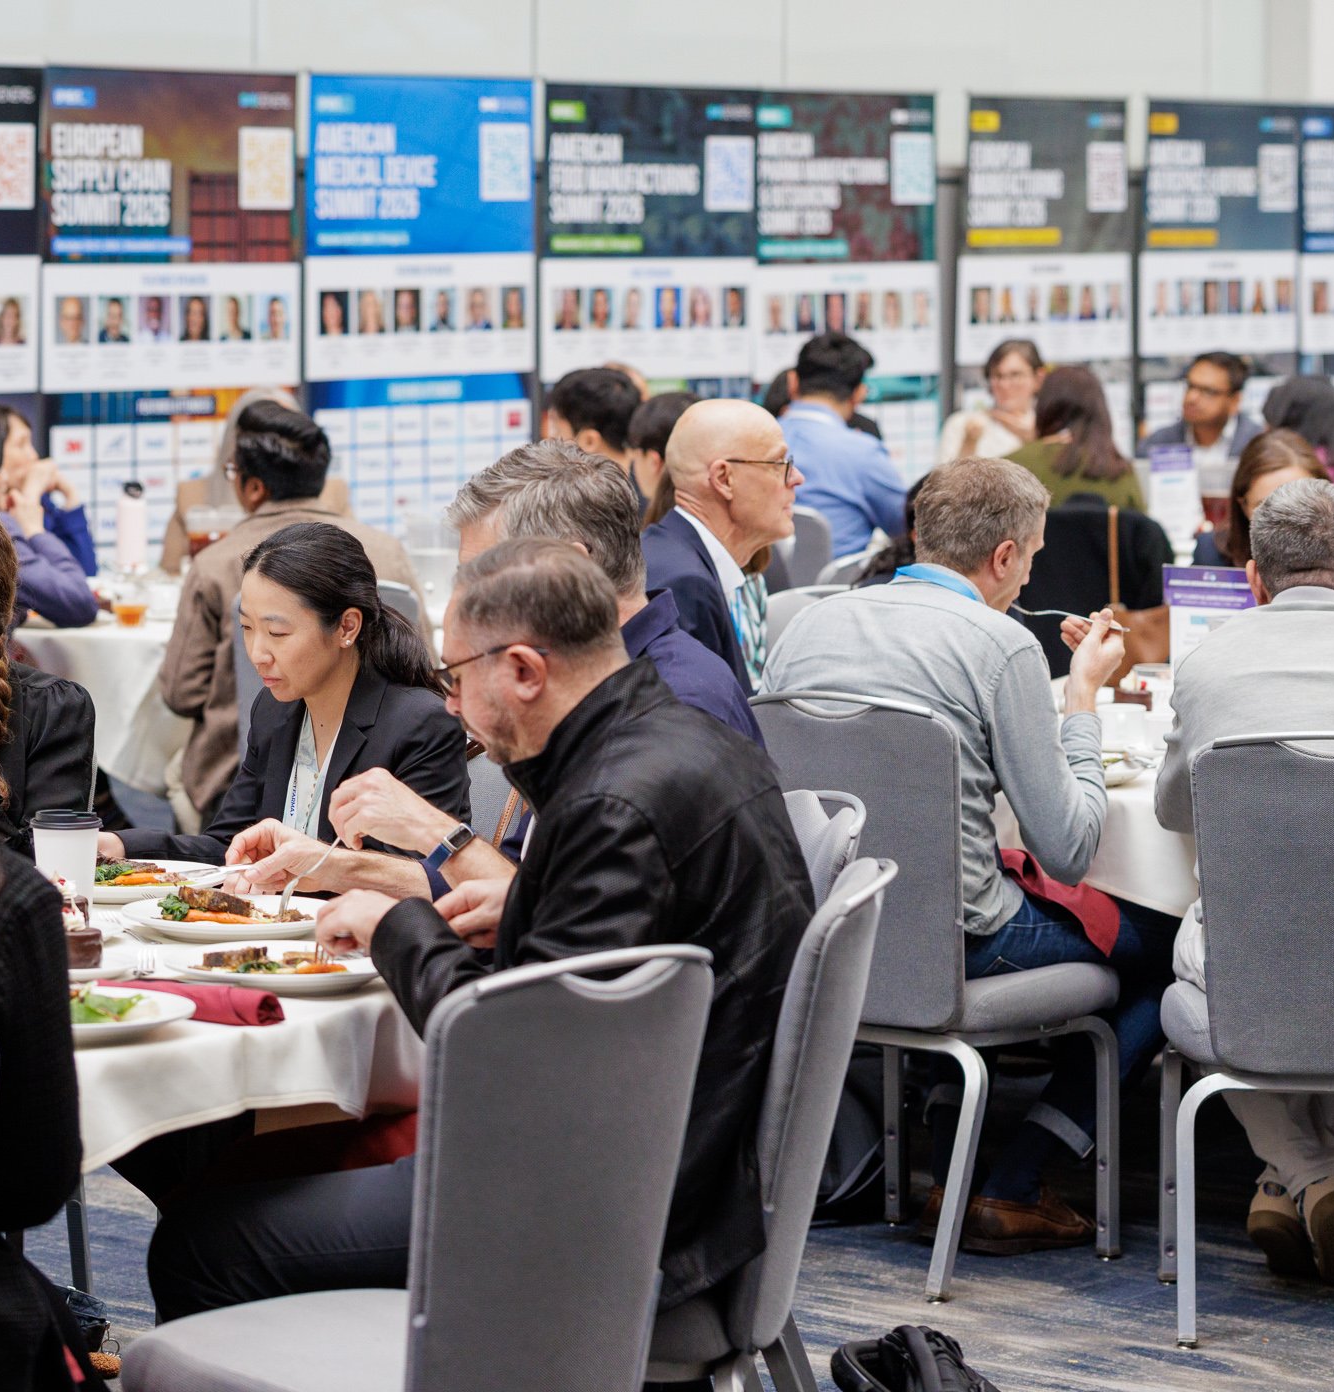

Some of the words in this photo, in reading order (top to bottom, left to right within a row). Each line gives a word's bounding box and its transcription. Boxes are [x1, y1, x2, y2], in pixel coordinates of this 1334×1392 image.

[51, 123, 144, 158] EUROPEAN
[316, 122, 396, 154] AMERICAN
[51, 158, 117, 191] SUPPLY
[118, 159, 172, 192] CHAIN
[315, 155, 382, 187] MEDICAL
[384, 155, 438, 188] DEVICE
[51, 193, 121, 226] SUMMIT
[315, 187, 377, 220] SUMMIT
[289, 789, 297, 814] FARMA
